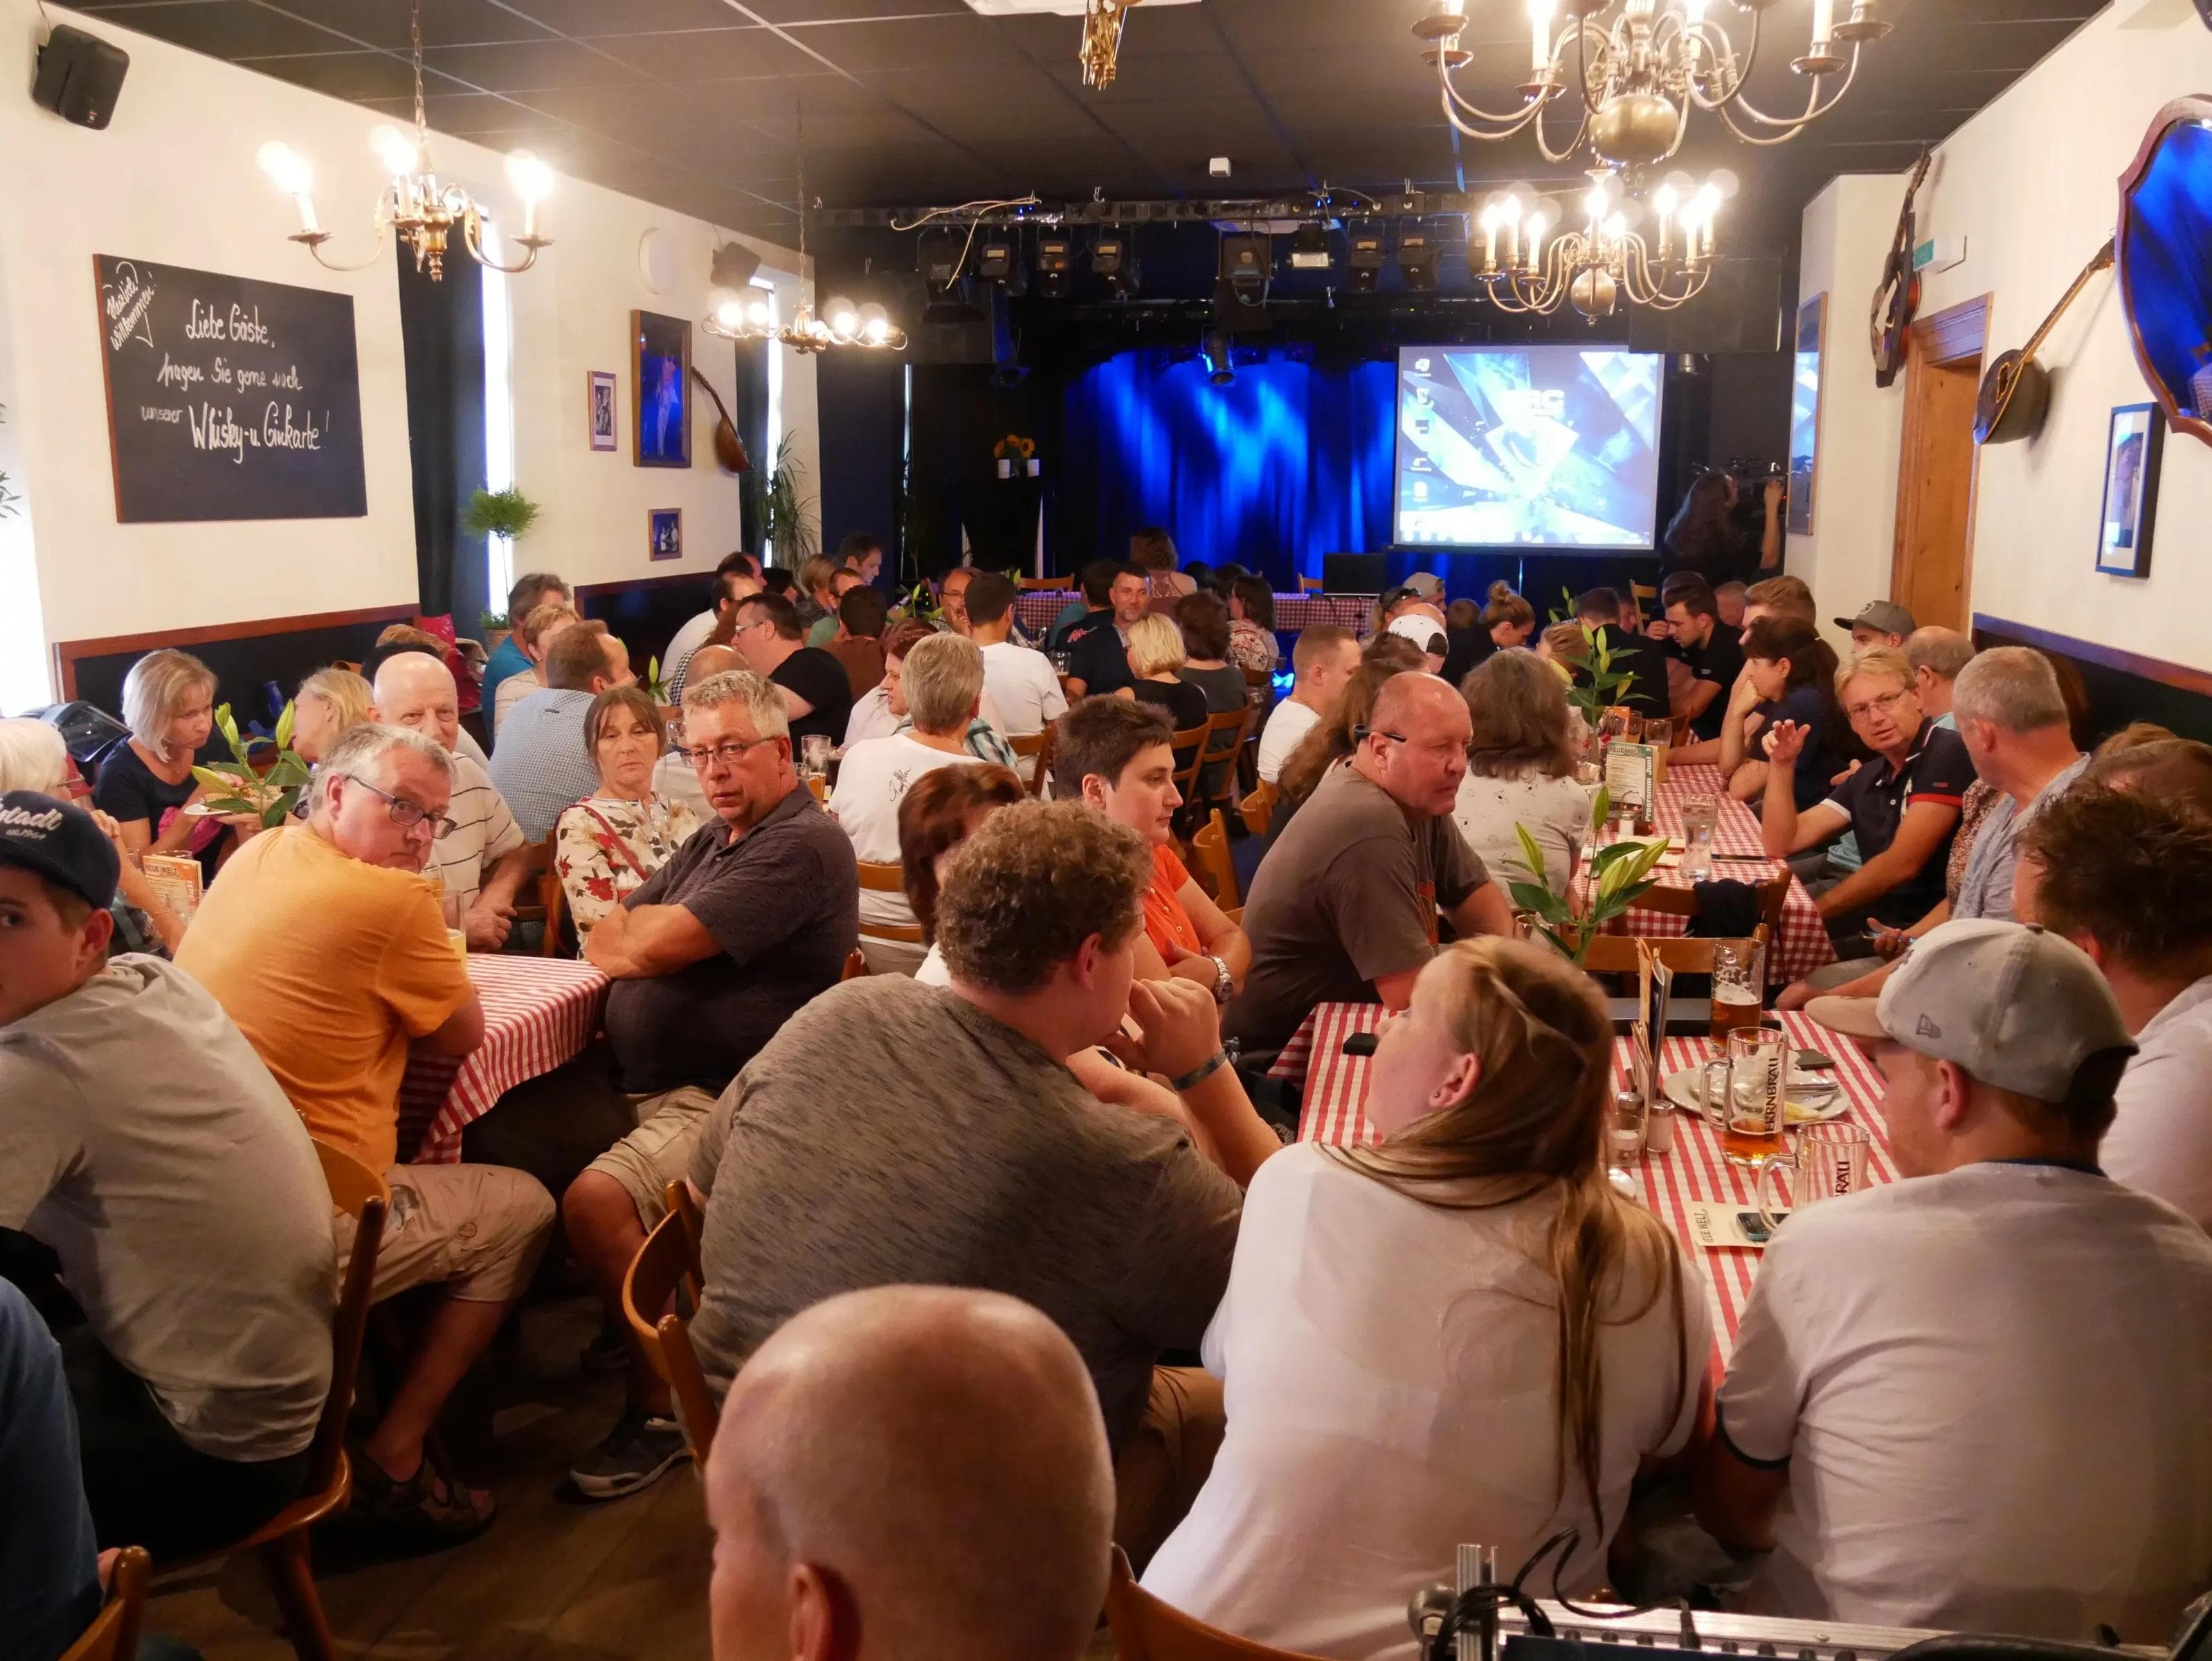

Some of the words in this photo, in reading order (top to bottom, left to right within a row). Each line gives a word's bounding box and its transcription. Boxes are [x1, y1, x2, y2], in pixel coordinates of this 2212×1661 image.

[185, 299, 226, 340] Liebe
[230, 303, 275, 348] Gäste,
[157, 352, 204, 392] fragen
[211, 356, 232, 383] Sie
[237, 368, 266, 394] gerne
[272, 365, 303, 391] nach
[140, 405, 183, 424] unserer
[1644, 777, 1653, 823] Programm
